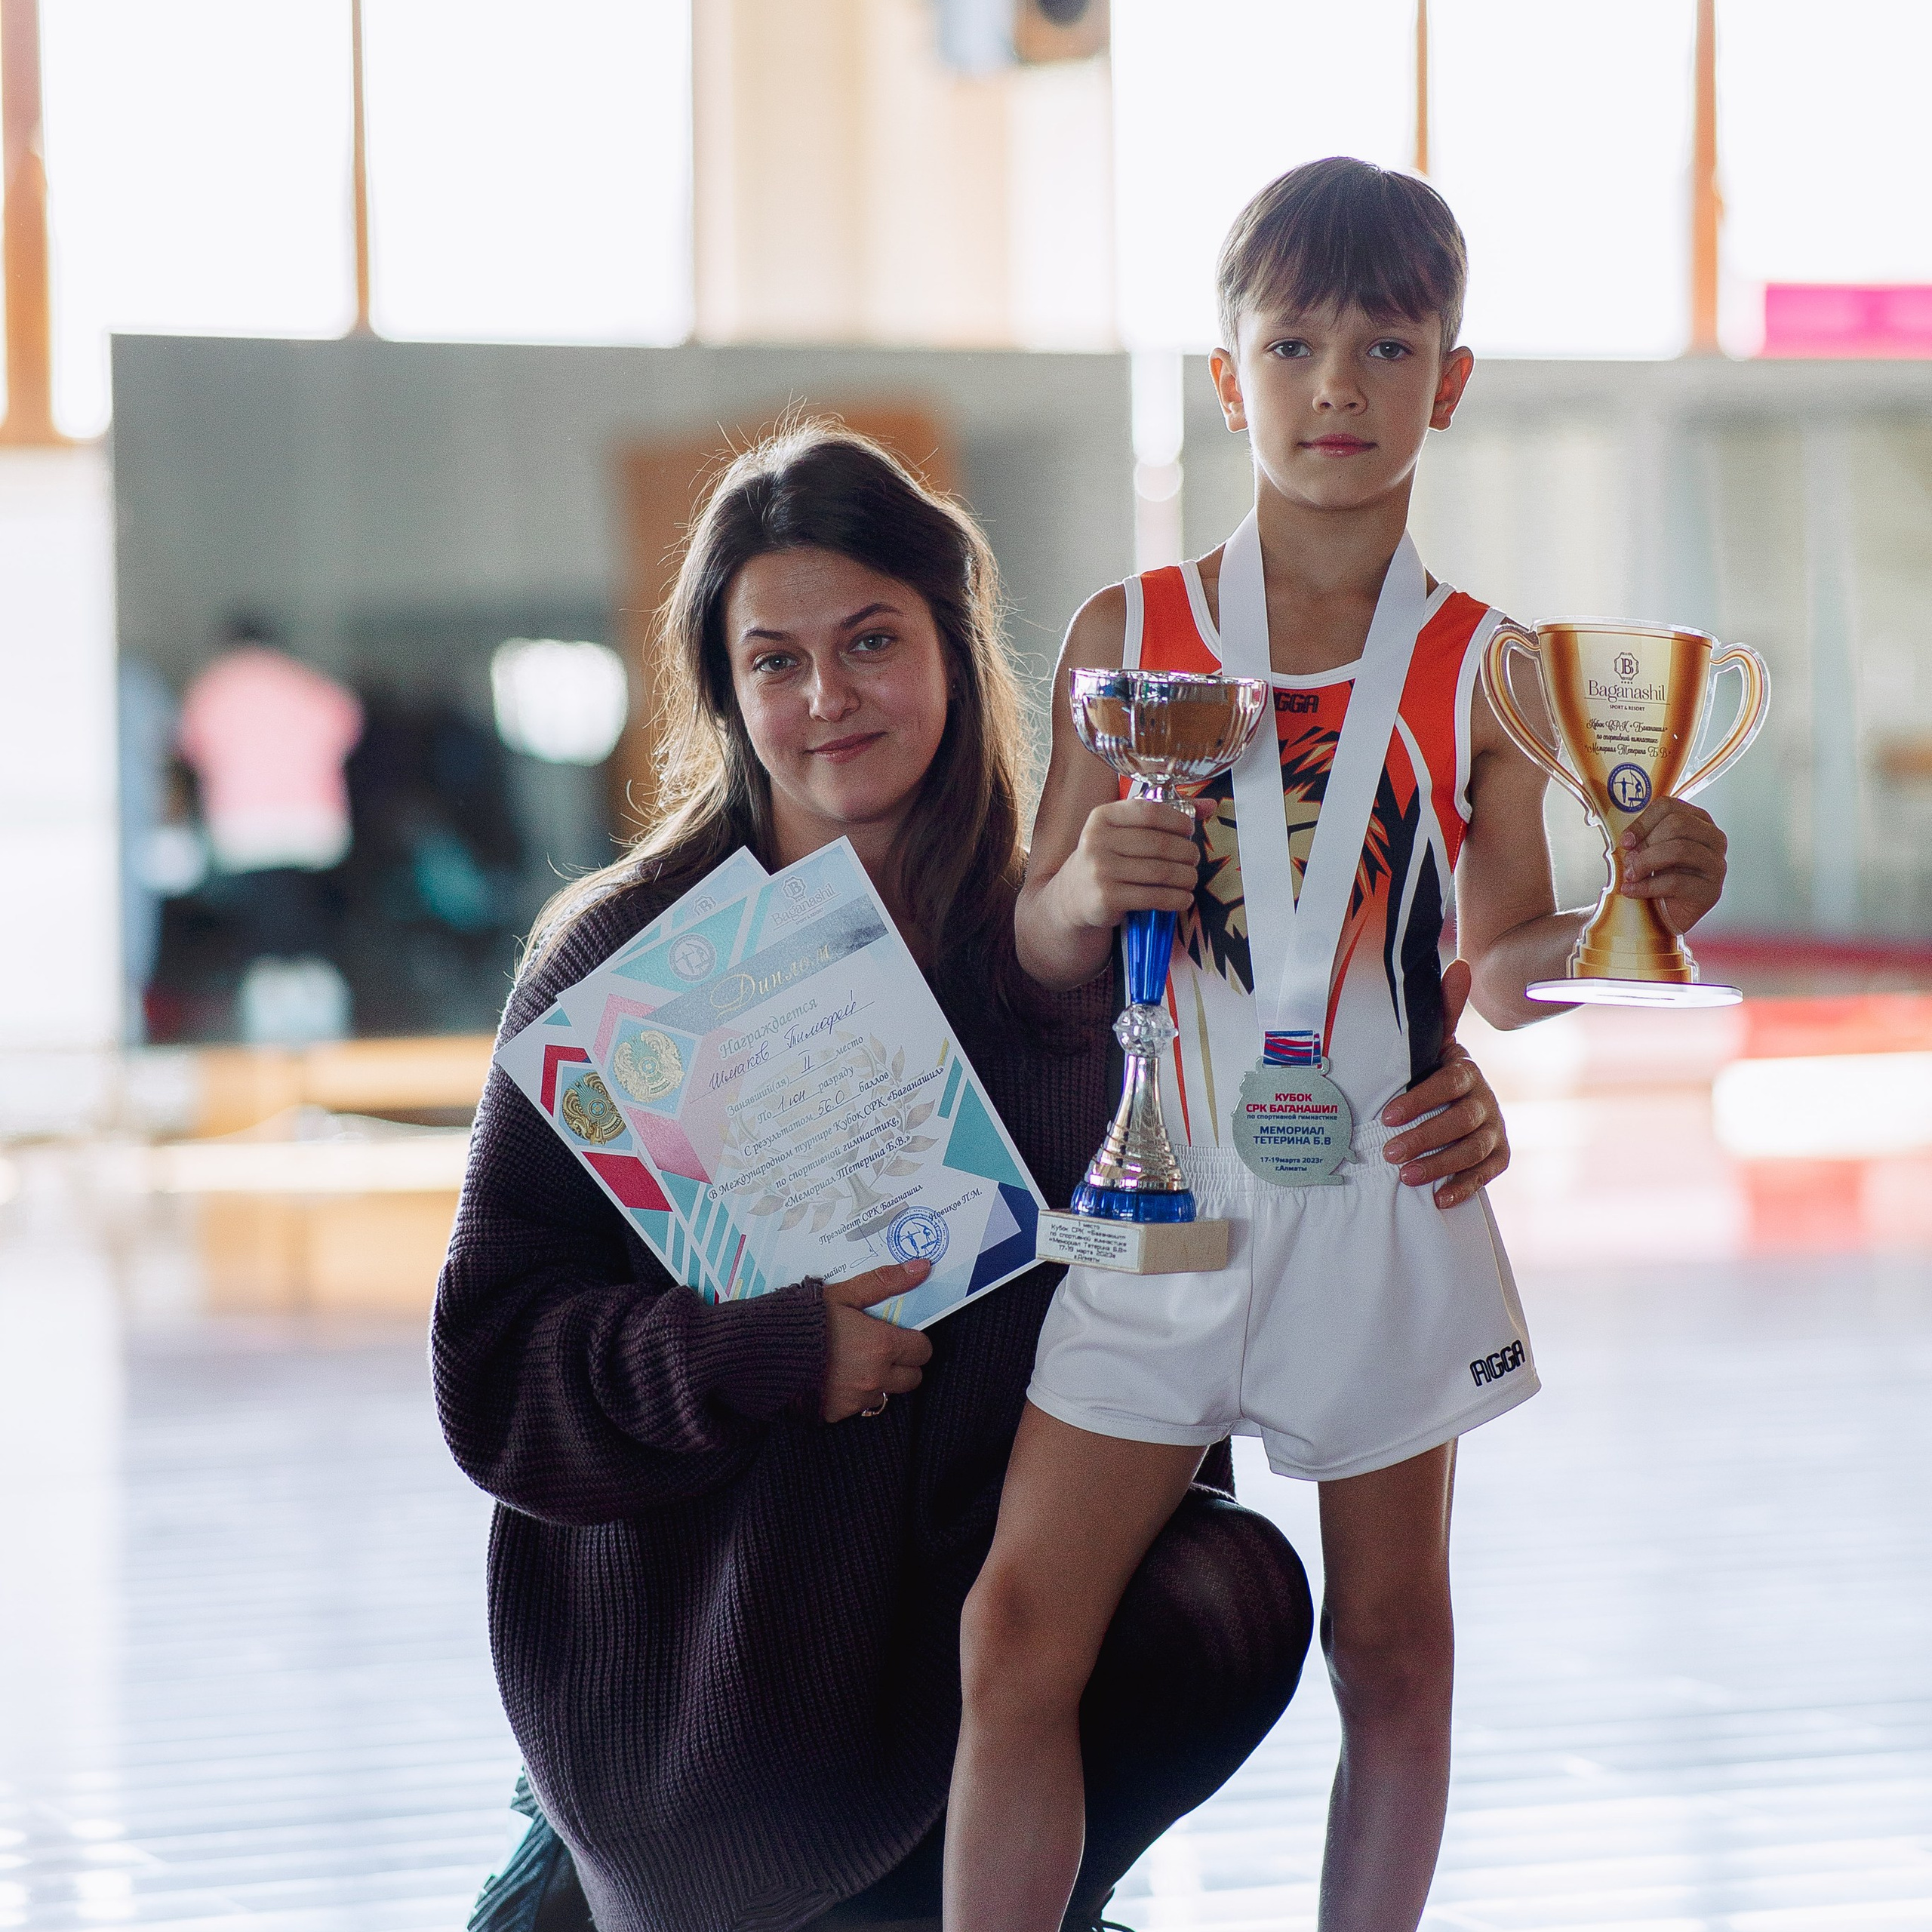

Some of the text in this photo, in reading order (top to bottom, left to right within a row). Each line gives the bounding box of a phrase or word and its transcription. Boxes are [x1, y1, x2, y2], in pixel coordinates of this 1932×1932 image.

[1274, 692, 1319, 713] GGA
[1589, 679, 1665, 703] Baganashil
[771, 883, 836, 927] Baganashil
[709, 945, 829, 1019] Диплом
[720, 998, 818, 1058] Награждается
[728, 1075, 789, 1117] Занявший(ая)
[836, 1035, 863, 1057] место
[758, 1111, 772, 1124] По
[818, 1066, 854, 1094] разряду
[1275, 1093, 1312, 1102] КУБОК
[709, 1067, 943, 1200] В Международном турнире Кубок СРК «Баганашил»
[744, 1146, 752, 1156] С
[753, 1114, 814, 1154] результатом
[859, 1072, 889, 1093] баллов
[1246, 1104, 1338, 1114] СРК БАГАНАШИЛ
[1260, 1126, 1324, 1135] МЕМОРИАЛ
[776, 1117, 900, 1189] по спортивной гимнастике,
[1254, 1137, 1331, 1146] ТЕТЕРИНА Б.В
[785, 1135, 911, 1208] «Мемориал Тетерина Б.В.»
[818, 1220, 862, 1245] Президент
[862, 1206, 883, 1223] СРК
[881, 1184, 924, 1214] Баганашил
[929, 1188, 983, 1221] Новиков П.М.
